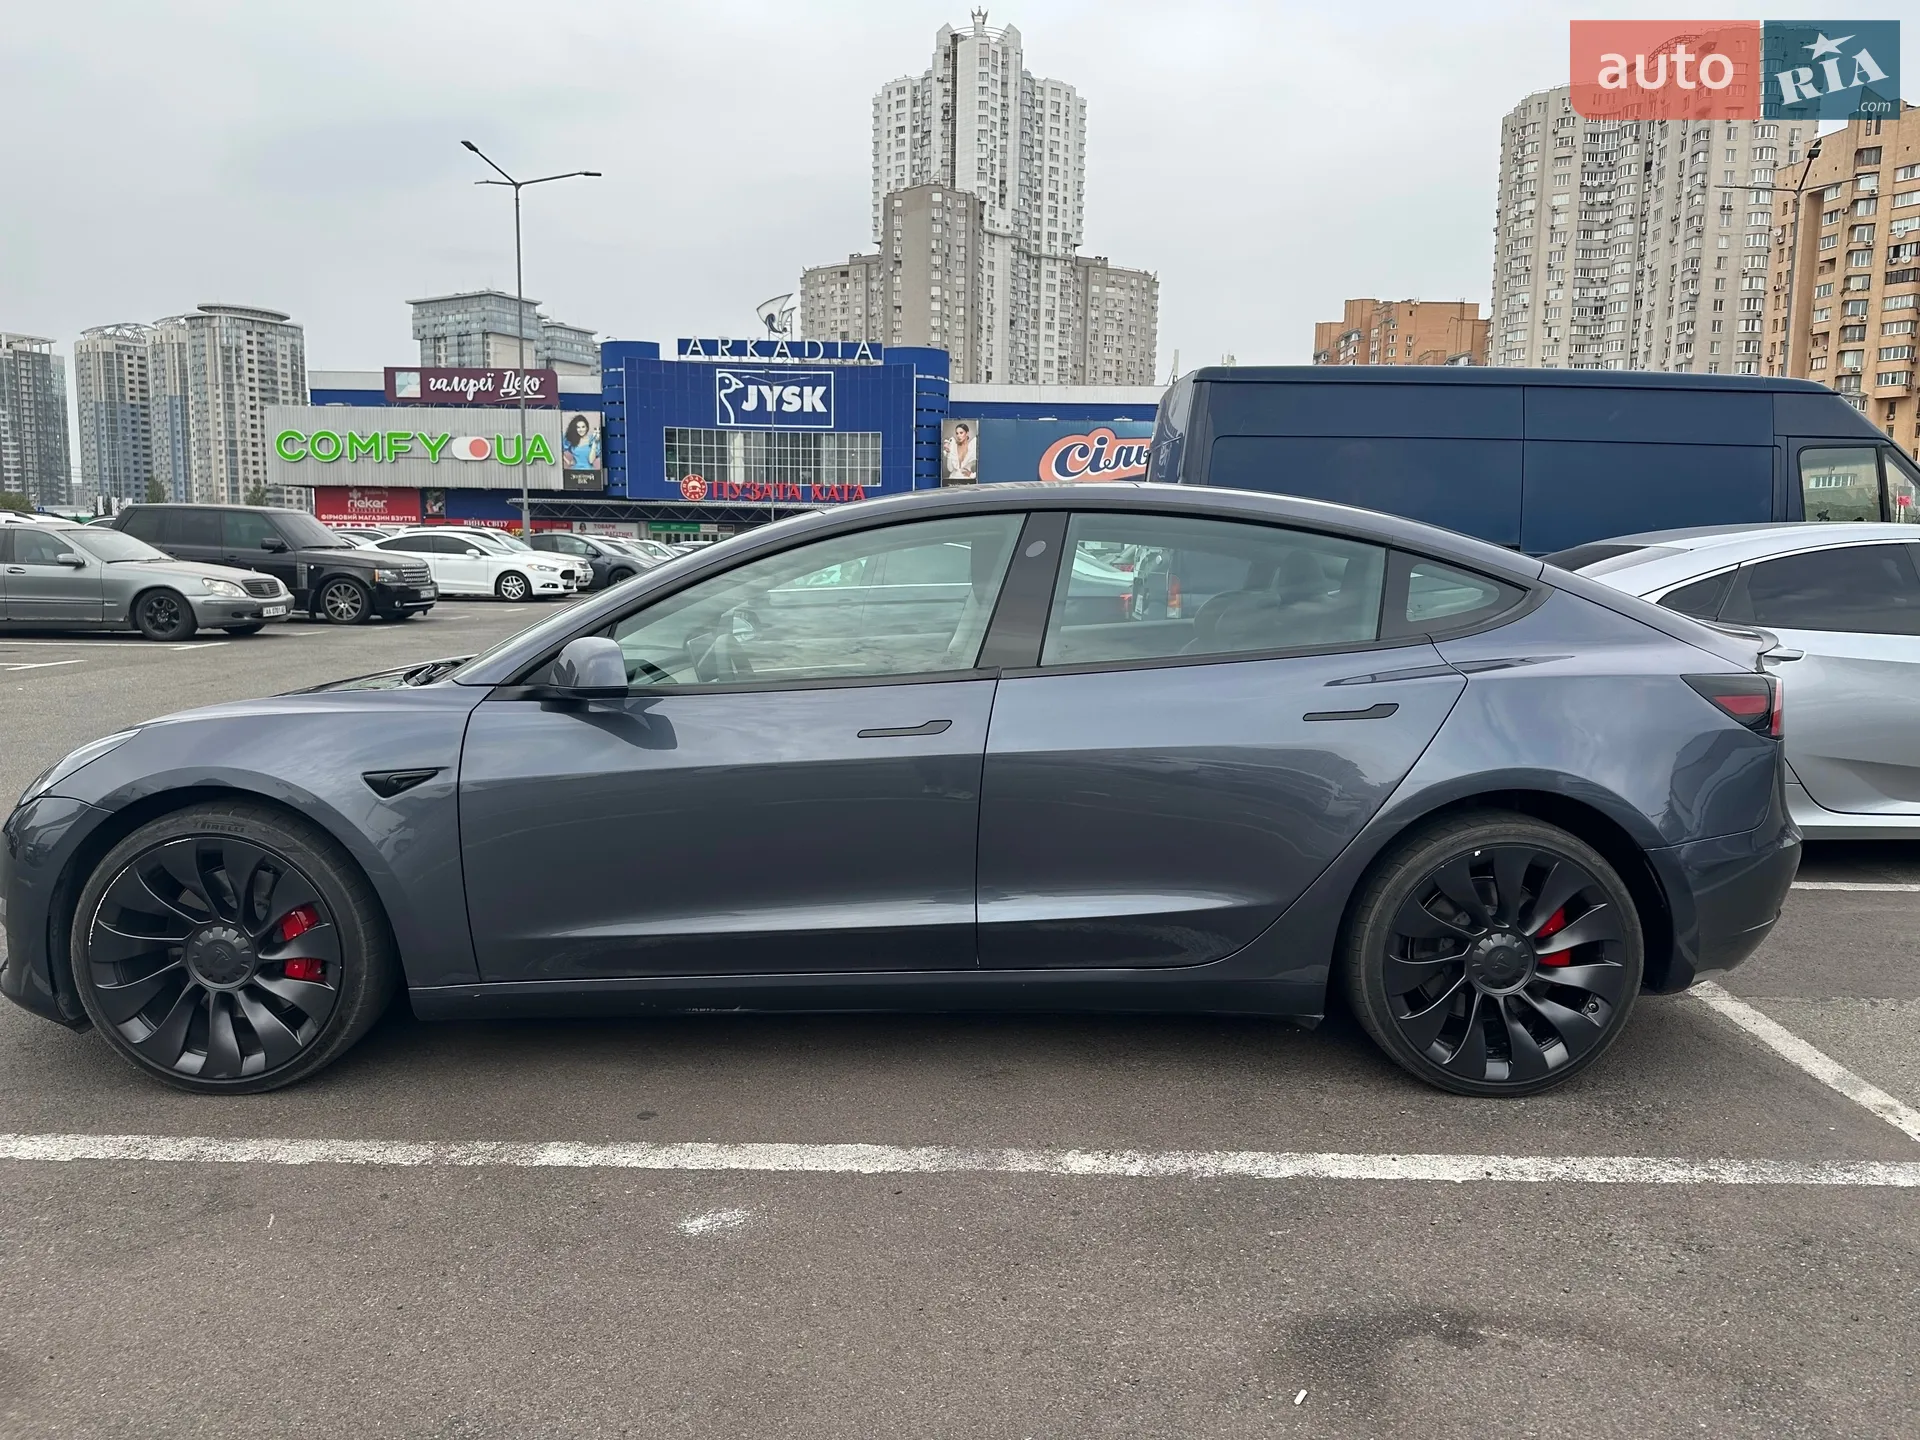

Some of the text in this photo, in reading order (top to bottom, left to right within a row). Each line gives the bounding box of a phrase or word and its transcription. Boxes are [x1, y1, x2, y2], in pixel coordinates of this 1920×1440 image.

[685, 336, 875, 362] ARKADIA
[428, 372, 495, 401] галереї
[741, 385, 828, 413] JYSK
[274, 429, 555, 465] COMFY UA
[347, 496, 388, 508] rieker
[711, 481, 867, 502] ПУЗАТА ХАТА
[320, 513, 358, 521] ФІРМОВИЙ
